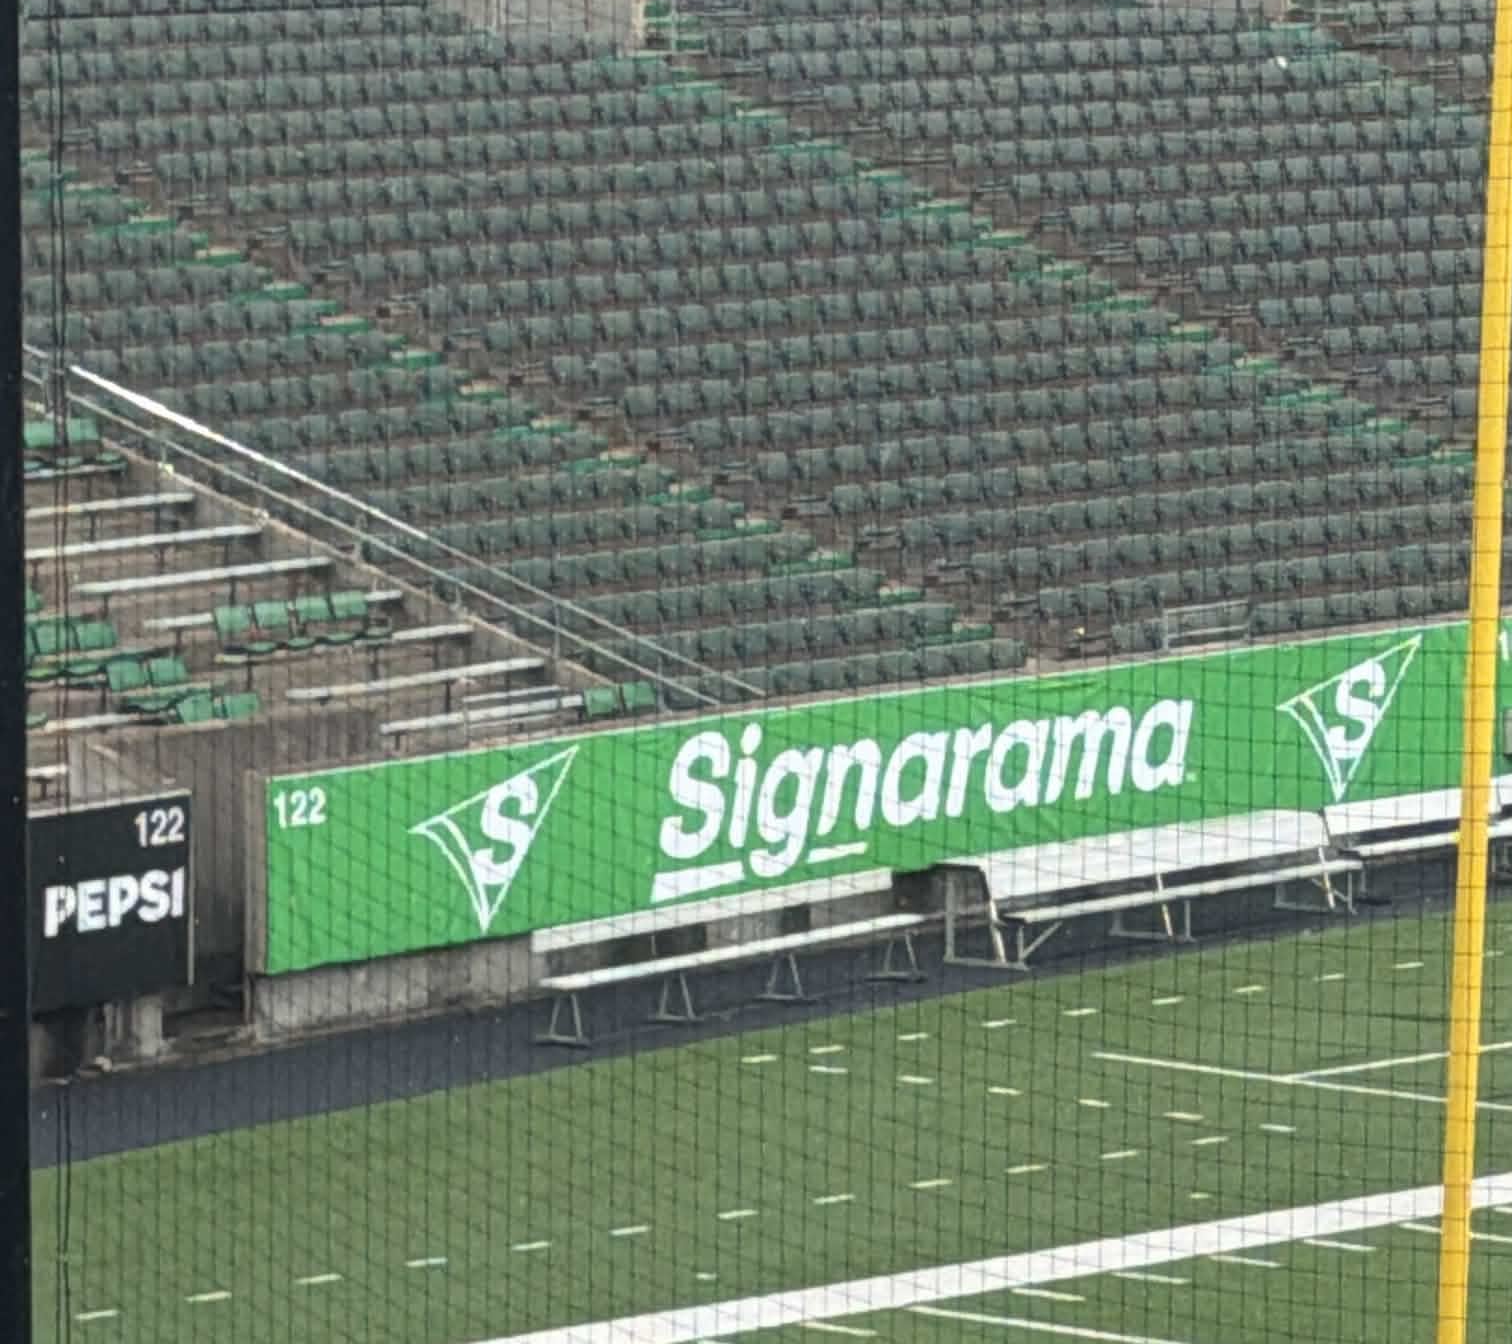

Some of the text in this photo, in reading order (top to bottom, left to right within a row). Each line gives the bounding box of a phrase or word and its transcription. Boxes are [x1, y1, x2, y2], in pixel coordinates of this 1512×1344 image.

[273, 786, 328, 829] 122
[659, 700, 1194, 877] Signarama
[134, 806, 185, 848] 122
[43, 865, 185, 939] PEPSI
